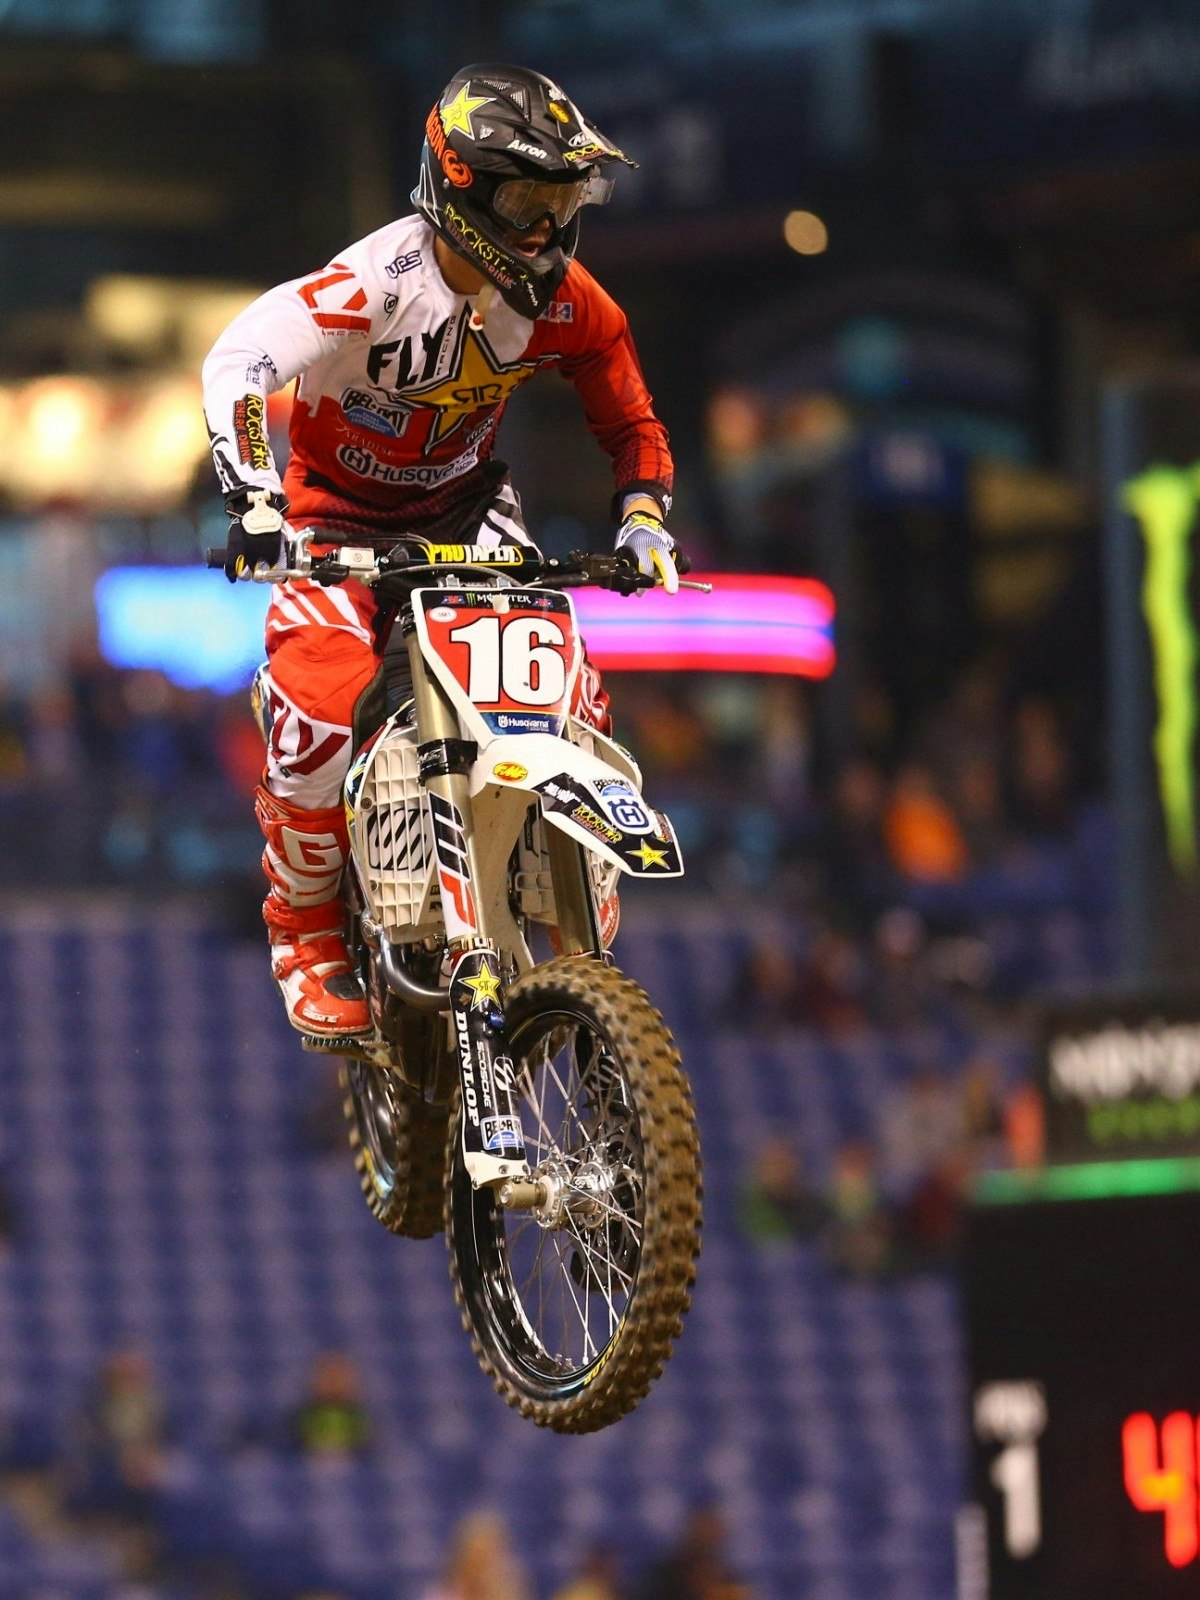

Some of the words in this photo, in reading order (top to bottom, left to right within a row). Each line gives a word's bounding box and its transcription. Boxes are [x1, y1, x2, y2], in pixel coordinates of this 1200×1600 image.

[366, 316, 450, 389] FLY
[246, 394, 271, 471] ROCSTAR
[371, 446, 477, 484] Husqva
[476, 593, 531, 604] MOTER
[450, 616, 566, 707] 16
[508, 718, 550, 730] Husqvarna
[455, 1010, 480, 1127] DUNLOP
[476, 1040, 492, 1109] SCOSCHE
[1120, 1408, 1200, 1569] 4
